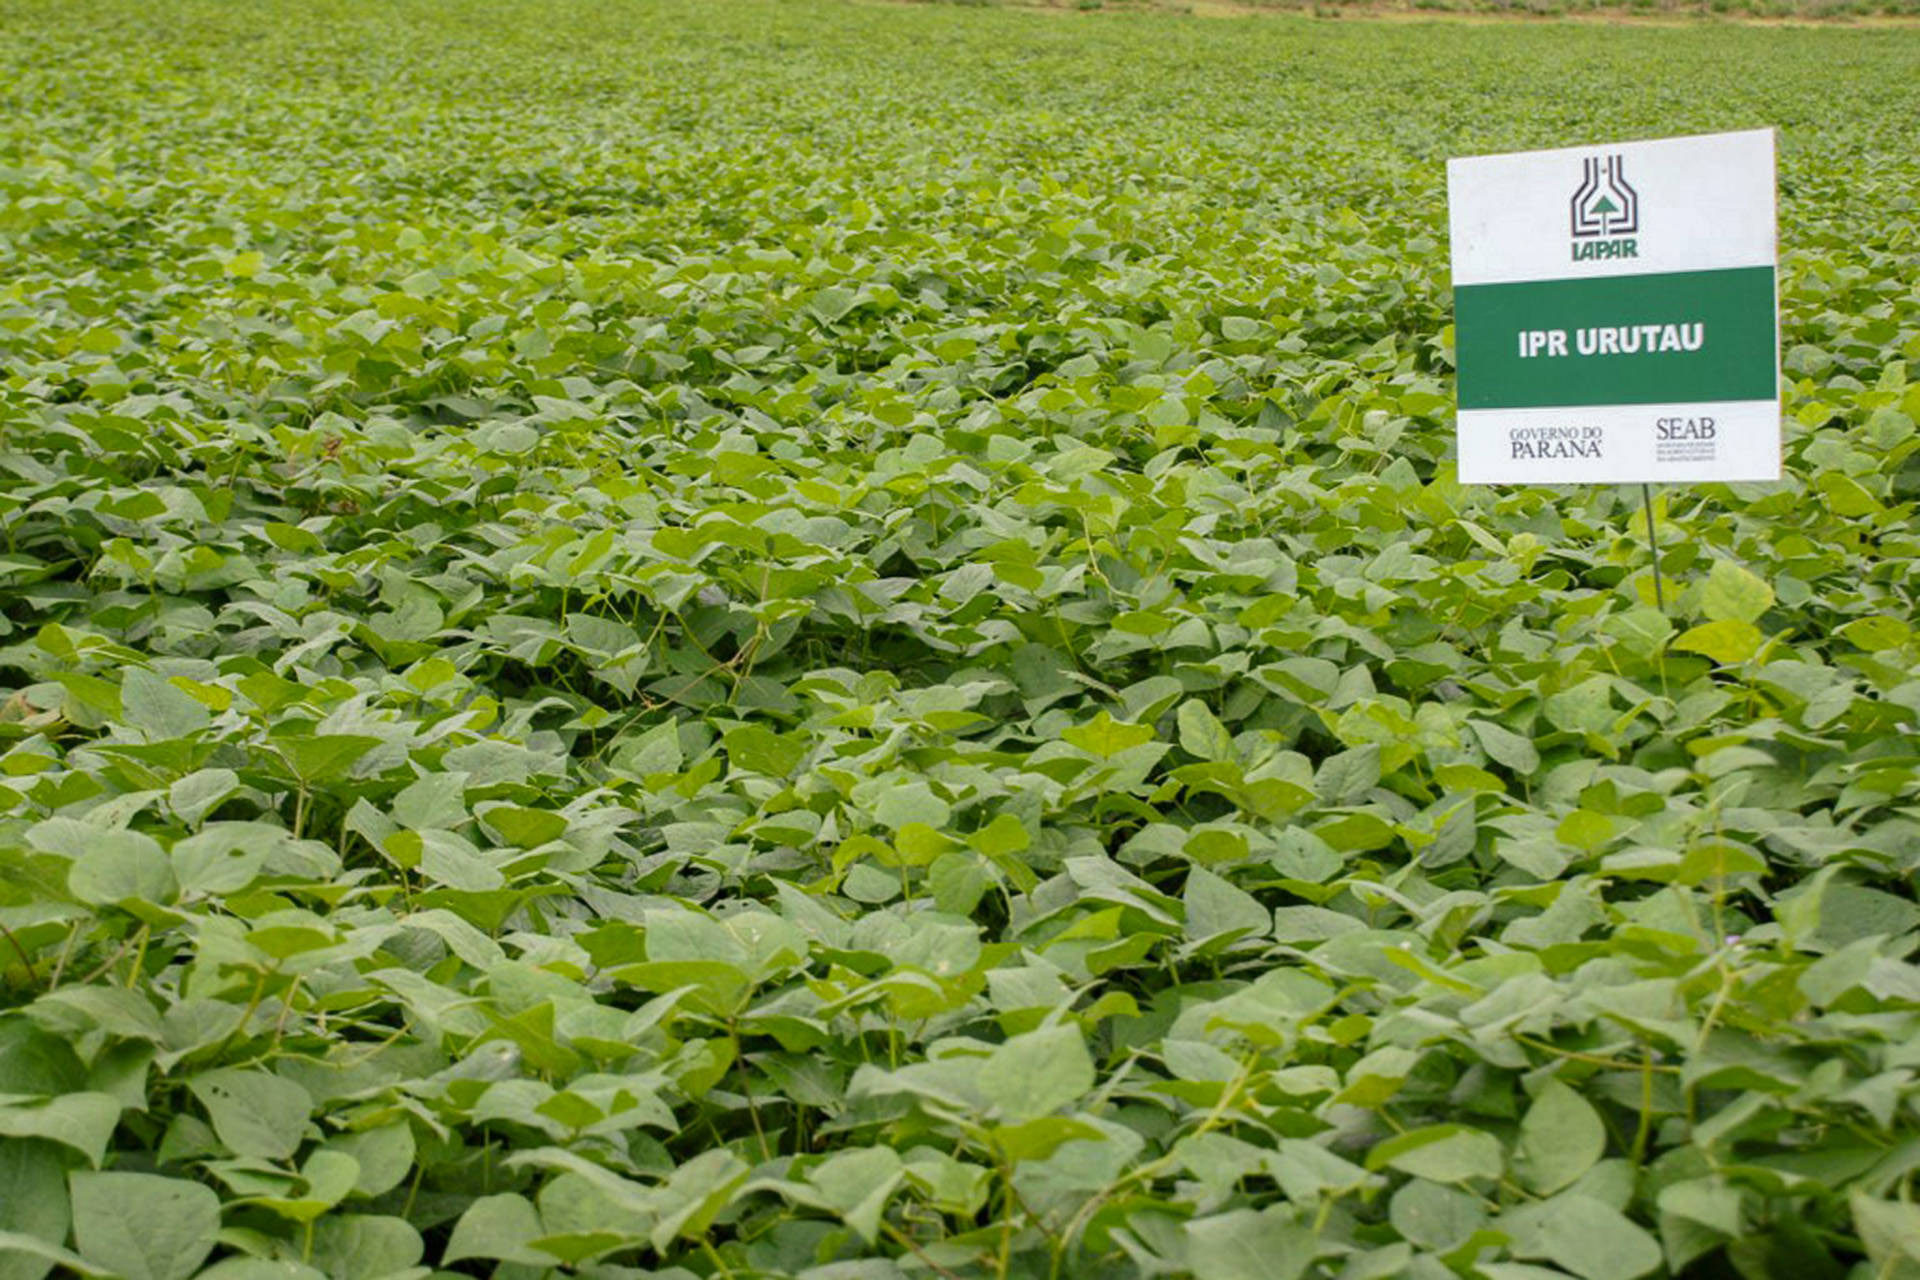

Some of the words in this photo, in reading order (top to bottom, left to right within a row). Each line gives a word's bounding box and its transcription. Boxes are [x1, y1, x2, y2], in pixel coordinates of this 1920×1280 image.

[1518, 328, 1568, 358] IPR
[1576, 322, 1704, 356] URUTAU
[1509, 427, 1578, 441] GOVERNO
[1582, 426, 1602, 438] DO
[1656, 417, 1716, 440] SEAB
[1511, 439, 1602, 459] PARANÁ
